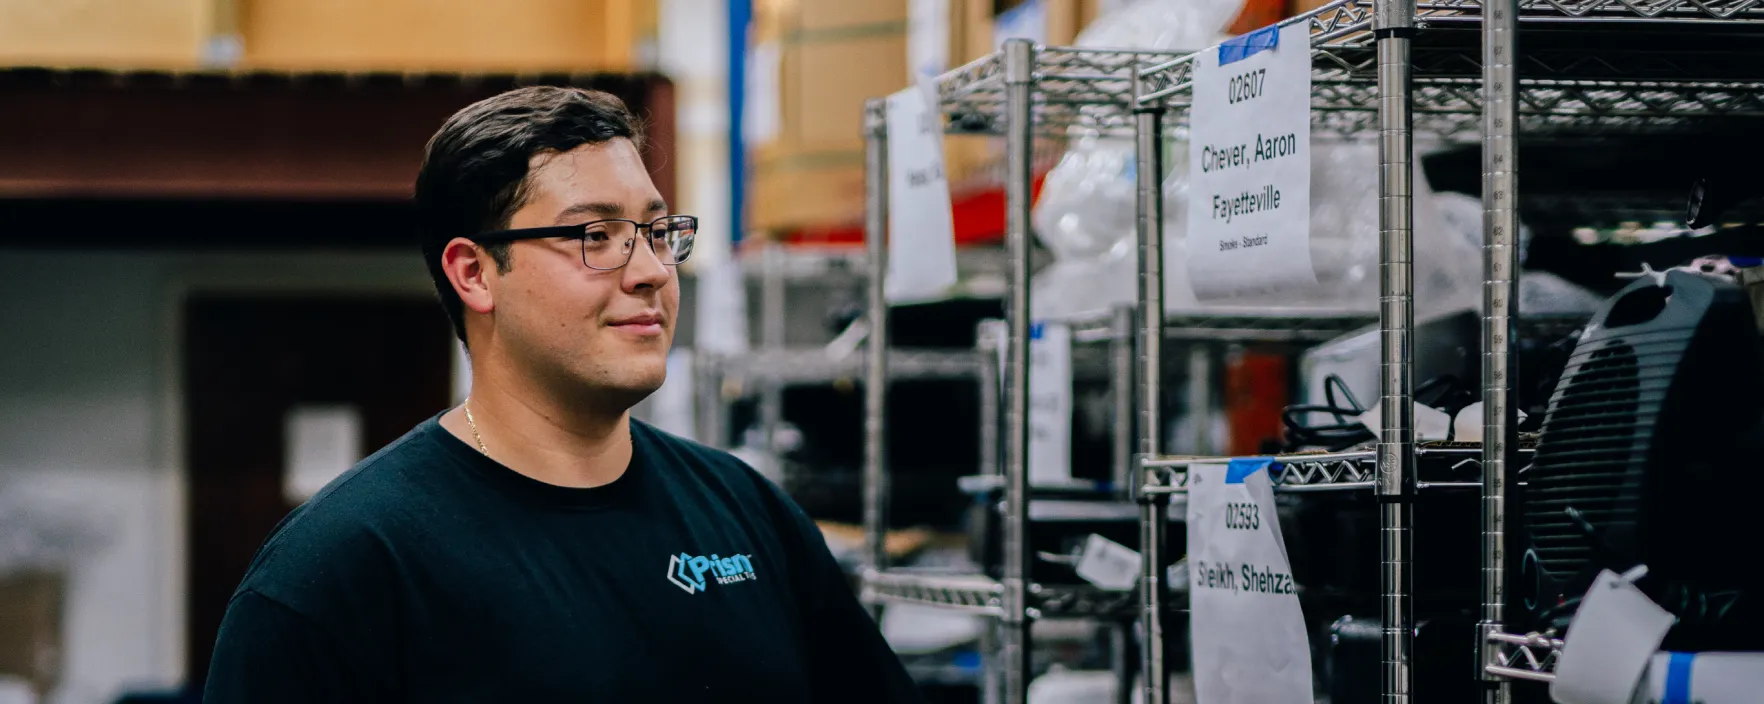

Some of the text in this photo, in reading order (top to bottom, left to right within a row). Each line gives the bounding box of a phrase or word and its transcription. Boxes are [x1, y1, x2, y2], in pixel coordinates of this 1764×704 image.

[1228, 68, 1266, 105] 02607
[1201, 132, 1296, 173] Chever, Aaron
[1212, 184, 1281, 224] Fayetteville
[1219, 239, 1238, 251] Smoke
[1243, 233, 1269, 248] Standard
[1226, 502, 1260, 530] 02593
[1197, 559, 1298, 596] Seikh, Shehza
